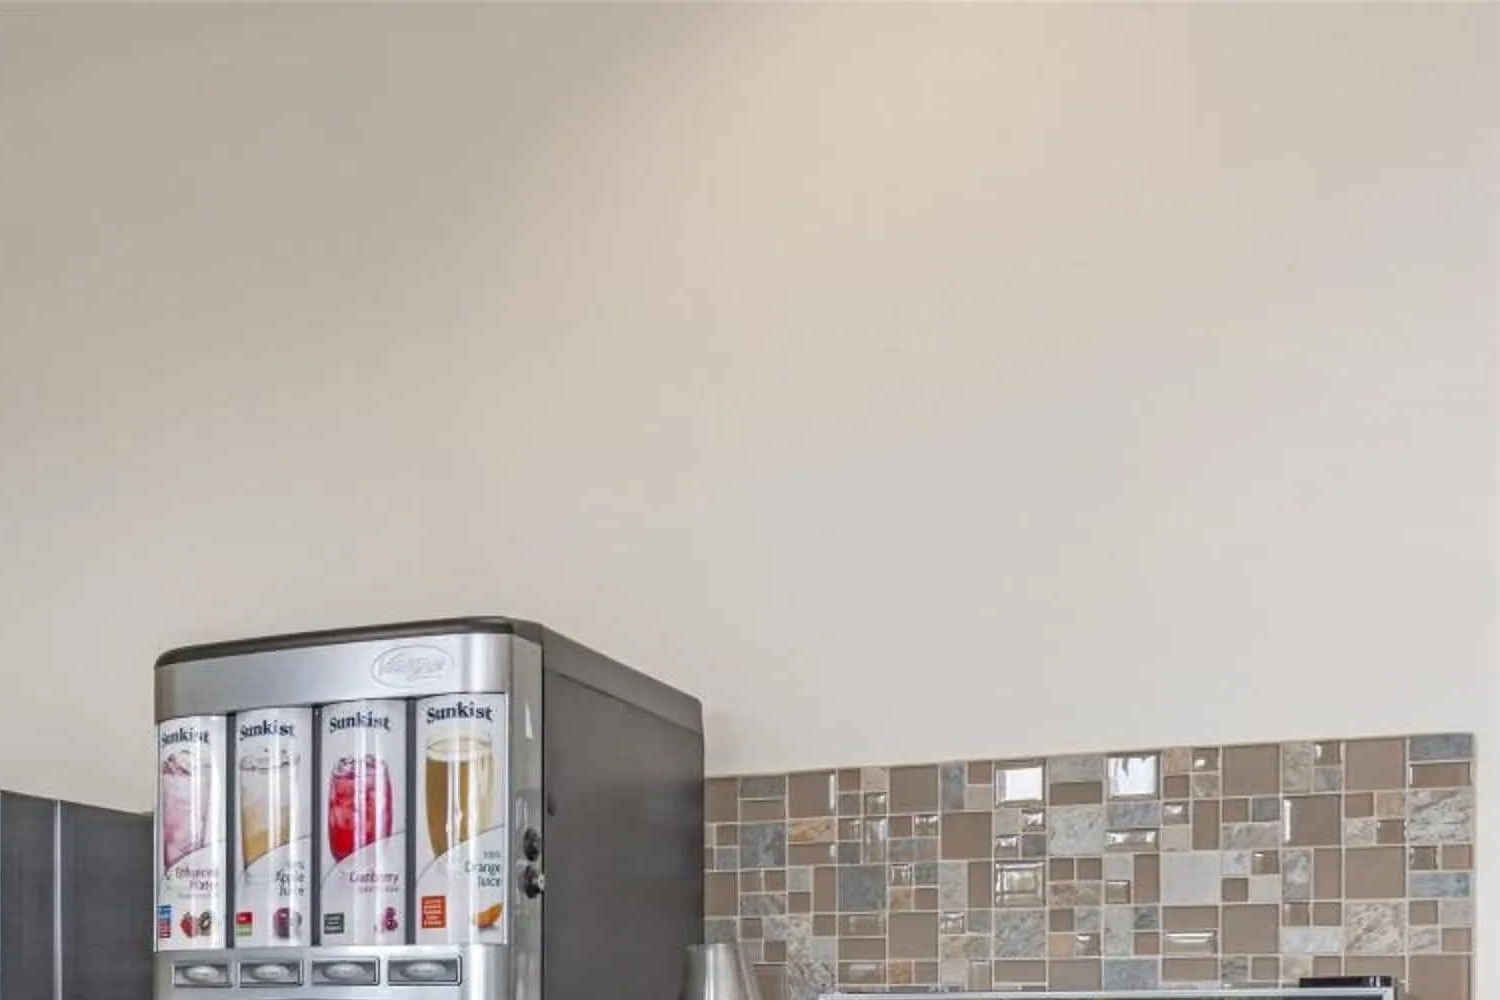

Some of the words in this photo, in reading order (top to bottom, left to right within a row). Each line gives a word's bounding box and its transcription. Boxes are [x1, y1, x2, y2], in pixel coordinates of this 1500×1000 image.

[328, 710, 392, 734] Sunkist
[425, 700, 493, 724] Sunkist
[238, 719, 296, 742] Sunkist
[349, 870, 399, 885] Cranbrry
